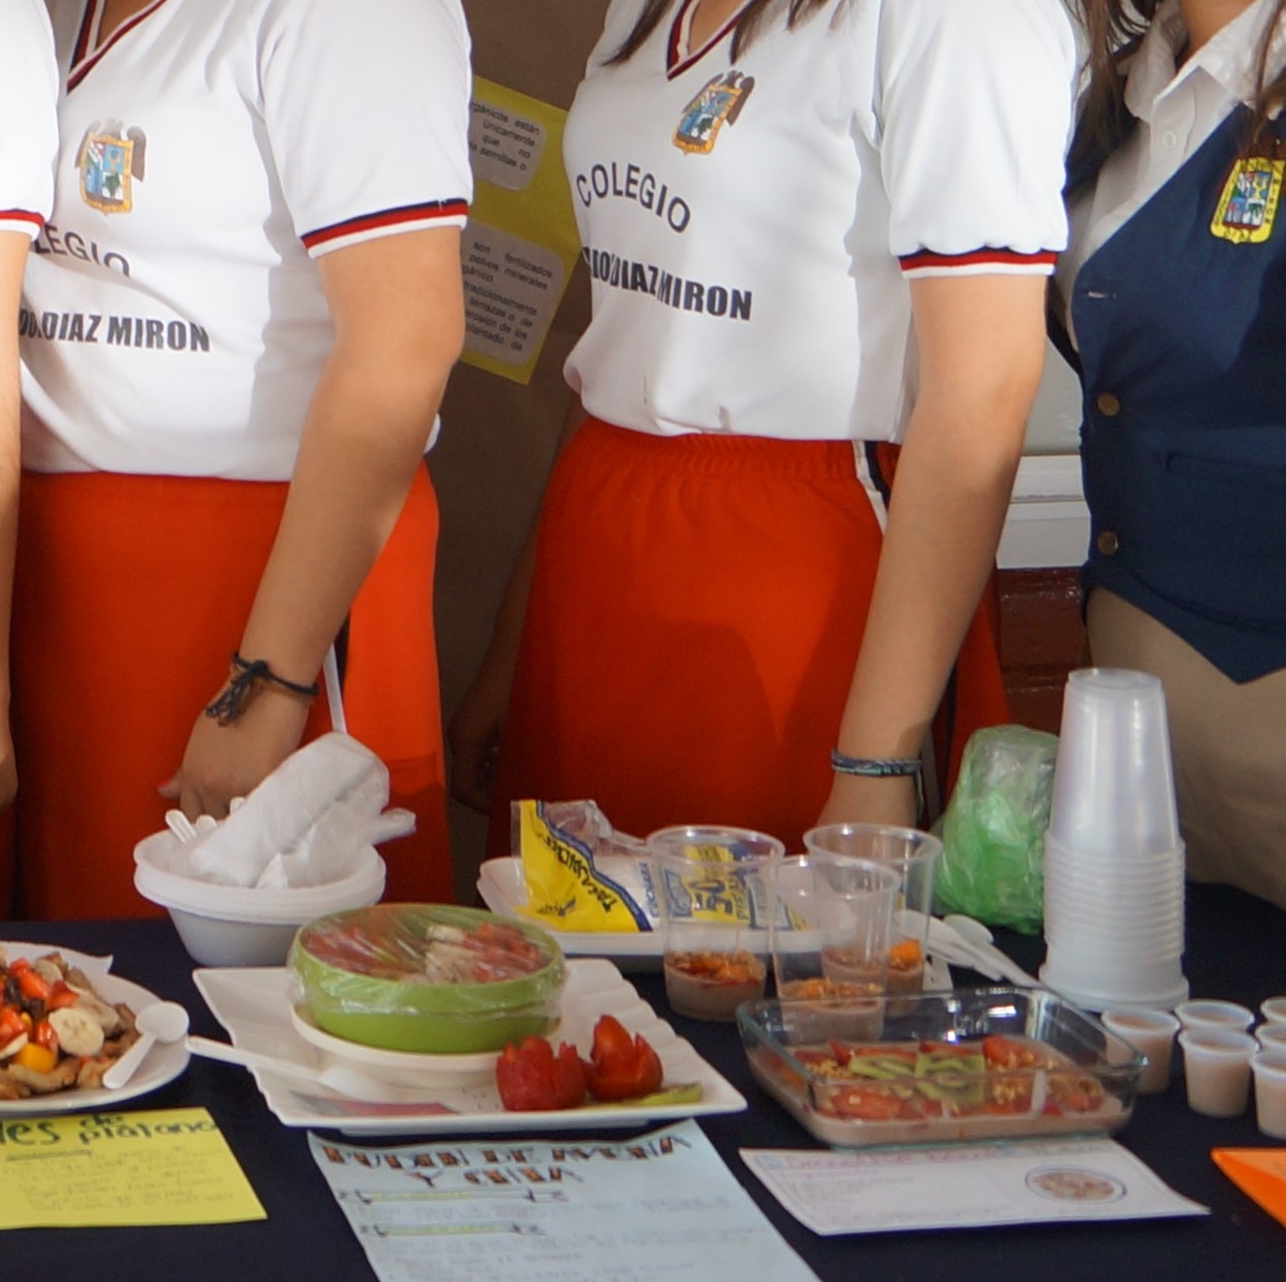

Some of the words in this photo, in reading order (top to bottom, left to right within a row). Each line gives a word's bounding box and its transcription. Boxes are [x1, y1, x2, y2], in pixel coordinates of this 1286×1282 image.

[576, 161, 691, 233] COLEGIO
[657, 269, 753, 321] MIRON
[42, 311, 102, 343] DIAZ
[106, 315, 211, 353] MIRON
